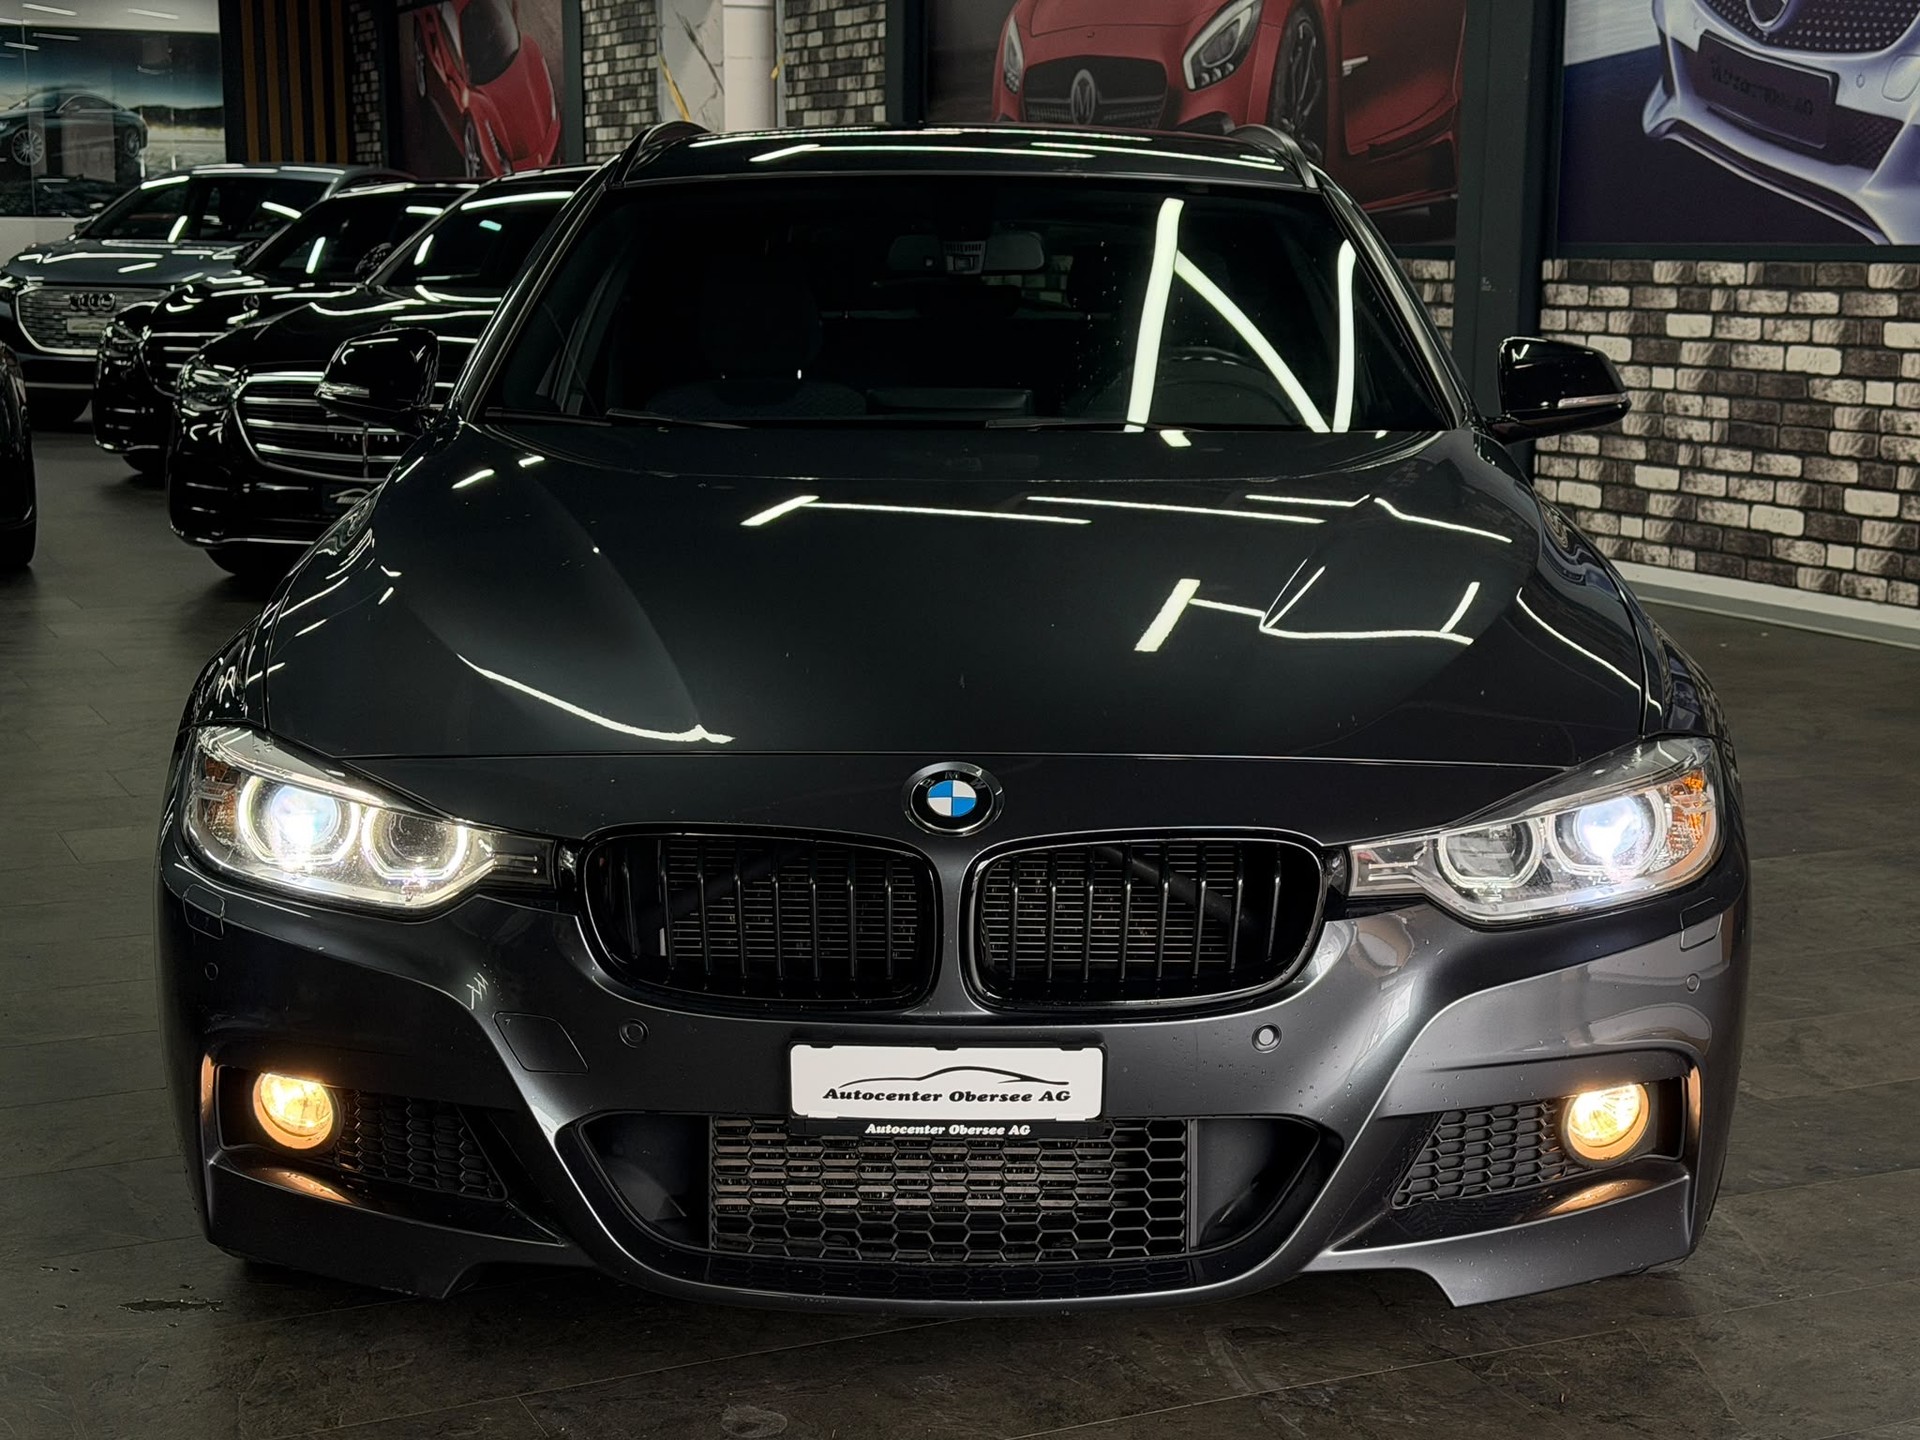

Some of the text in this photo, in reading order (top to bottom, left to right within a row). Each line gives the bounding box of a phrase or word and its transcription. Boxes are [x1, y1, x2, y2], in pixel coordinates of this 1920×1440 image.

[920, 770, 987, 790] BMW
[822, 1088, 1071, 1102] Autocenter Obersee AG
[865, 1123, 1031, 1136] Autocenter Obersee AG
